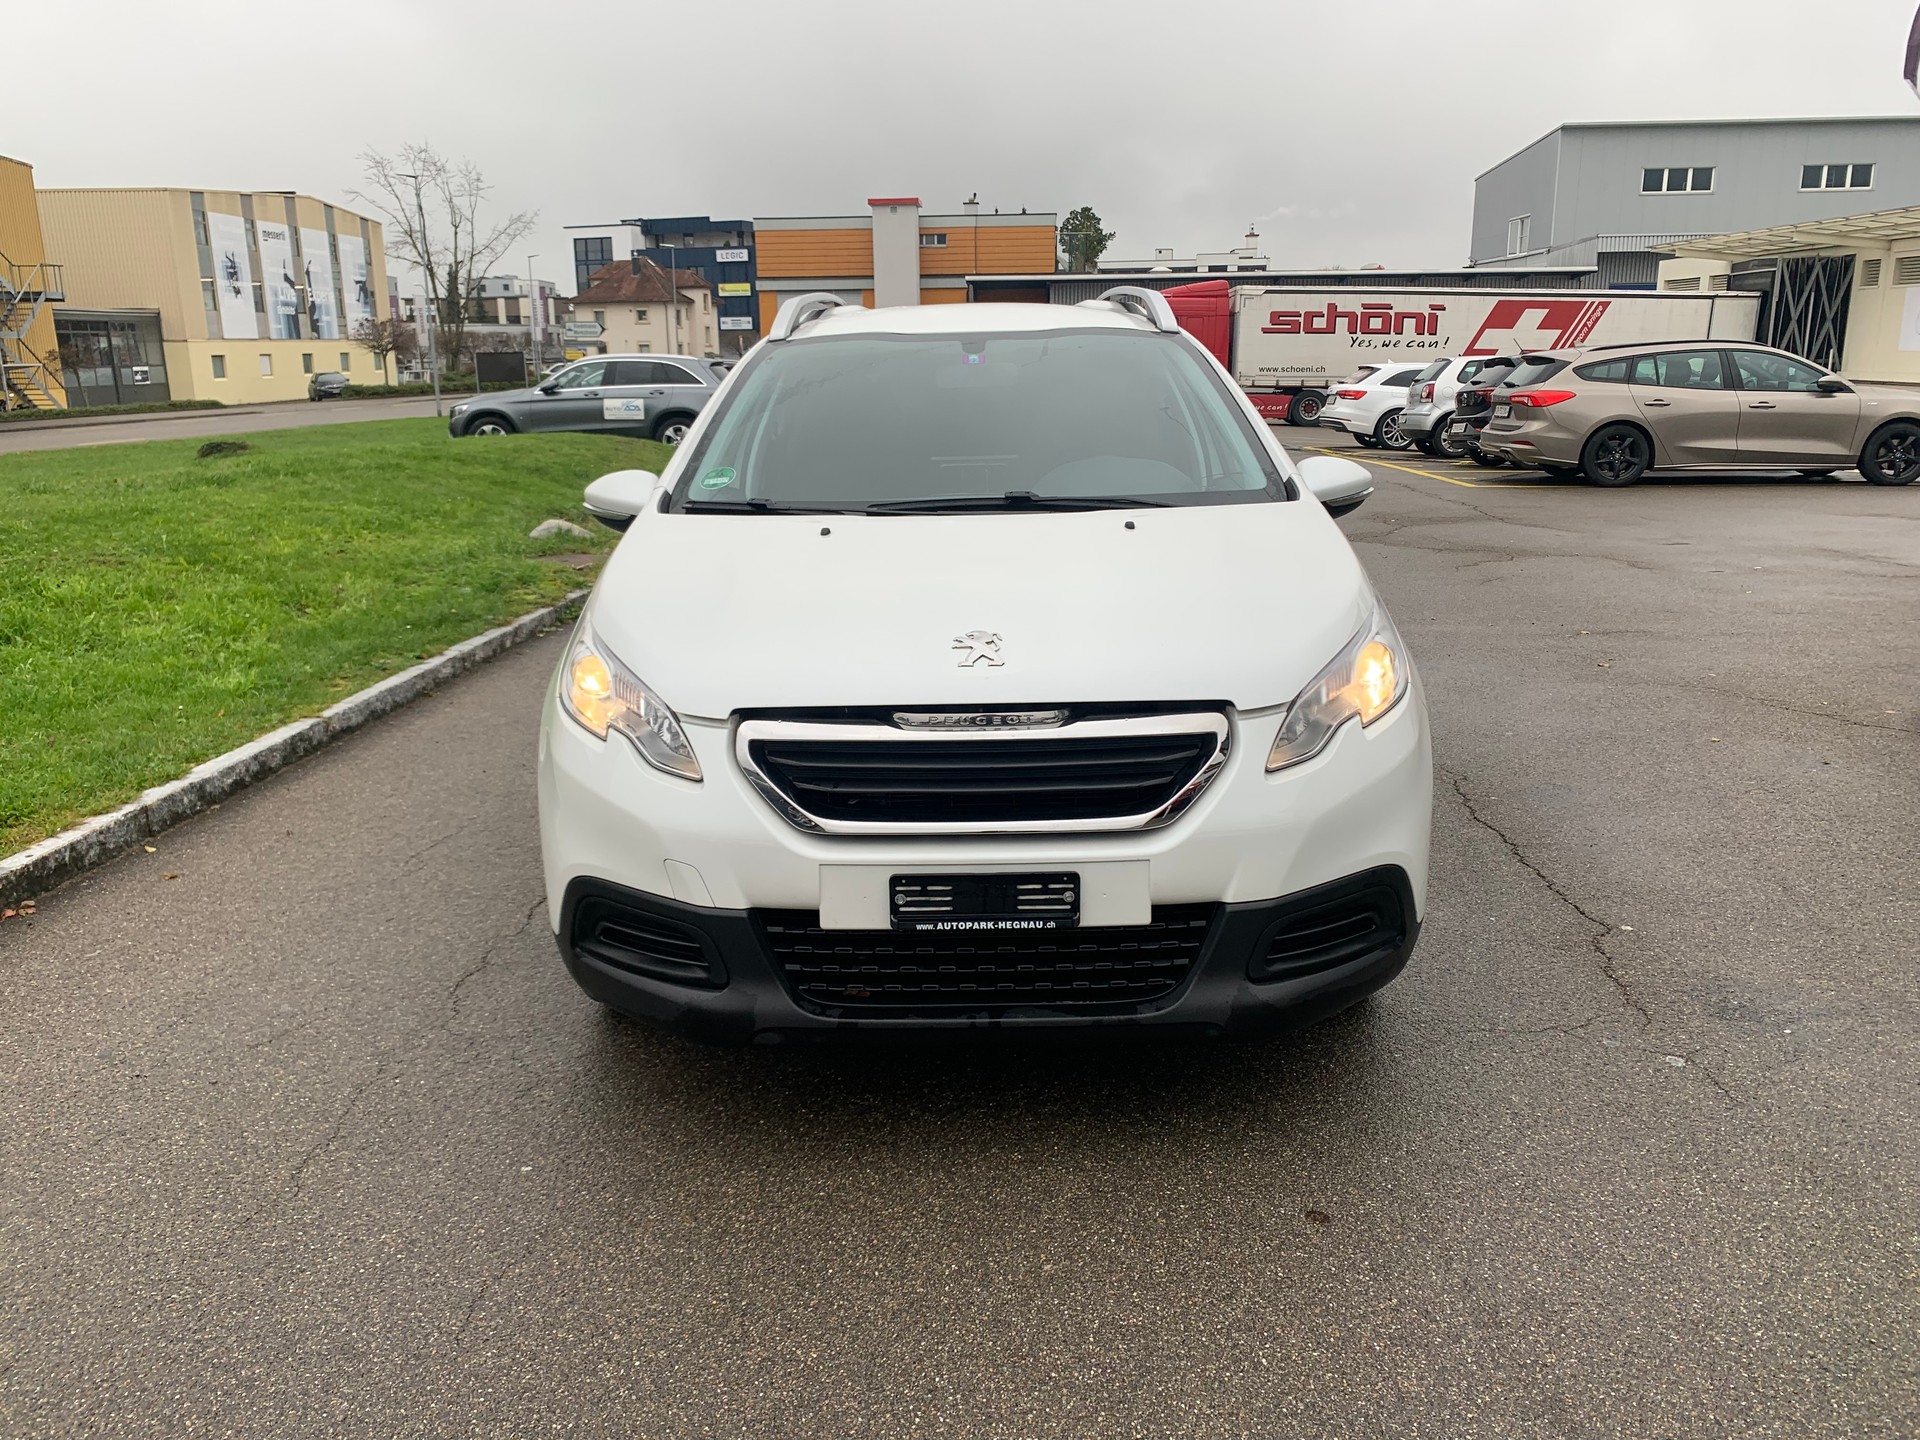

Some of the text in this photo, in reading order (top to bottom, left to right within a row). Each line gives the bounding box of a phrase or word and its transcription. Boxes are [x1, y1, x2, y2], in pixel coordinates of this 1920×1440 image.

[720, 251, 744, 260] LEGIC
[1350, 336, 1378, 349] Yes,
[1381, 339, 1401, 348] we
[1258, 365, 1326, 373] www.schoeni.ch
[928, 714, 1035, 726] PEUGEOT
[915, 920, 1057, 931] www.AUTOPARK-HEGNAU.ch
